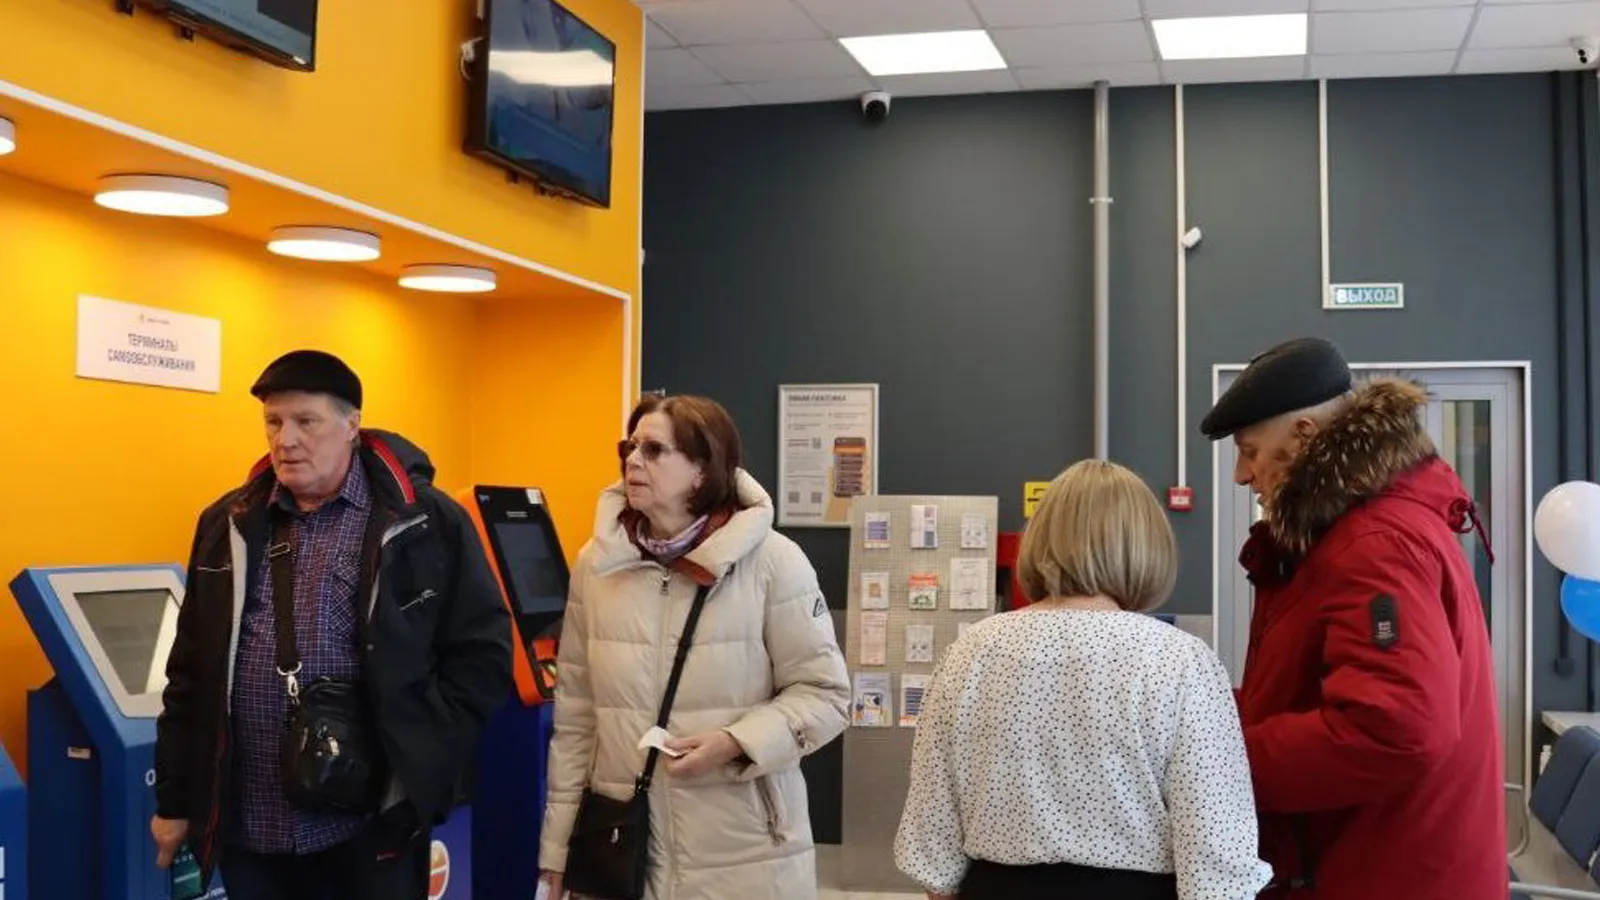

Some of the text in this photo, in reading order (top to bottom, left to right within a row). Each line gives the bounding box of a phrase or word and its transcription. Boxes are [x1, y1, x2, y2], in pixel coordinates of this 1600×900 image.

[1336, 288, 1396, 303] ВЫХОД
[128, 332, 179, 352] ТЕРМИНАЛЫ
[107, 348, 196, 372] САМООБСЛУЖИВАНИЯ
